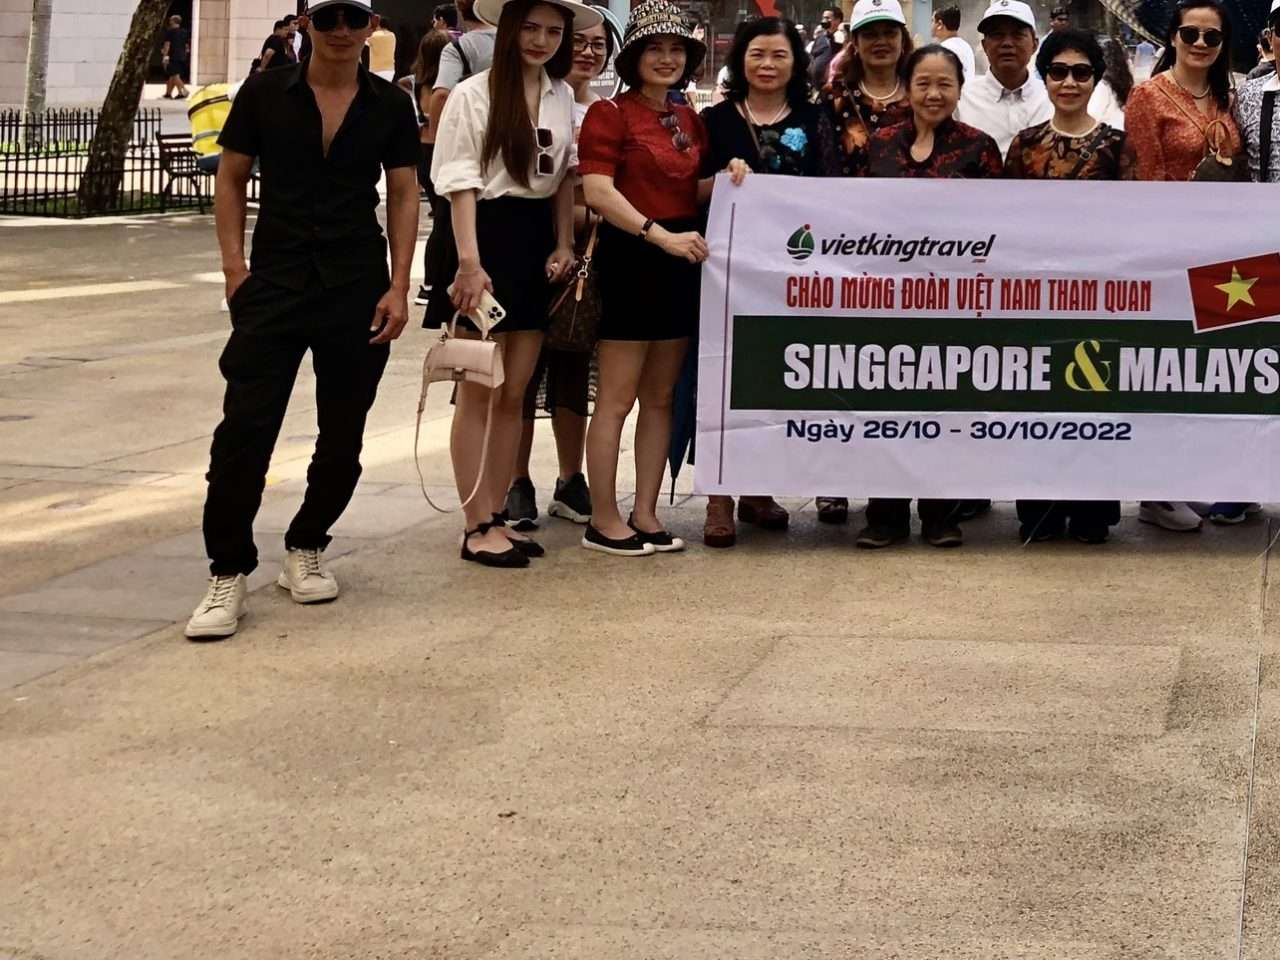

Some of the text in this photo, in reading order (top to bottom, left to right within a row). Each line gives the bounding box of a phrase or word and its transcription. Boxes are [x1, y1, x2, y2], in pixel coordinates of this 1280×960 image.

[821, 232, 997, 262] vietkingtravel
[786, 271, 1152, 317] CHÀO MỪNG ĐOÀN VIỆT NAM THAM QUAN
[783, 343, 1051, 391] SINGGAPORE
[1064, 340, 1112, 392] &
[786, 419, 855, 443] Ngày
[863, 420, 941, 439] 26/10
[970, 421, 1132, 441] 30/10/2022
